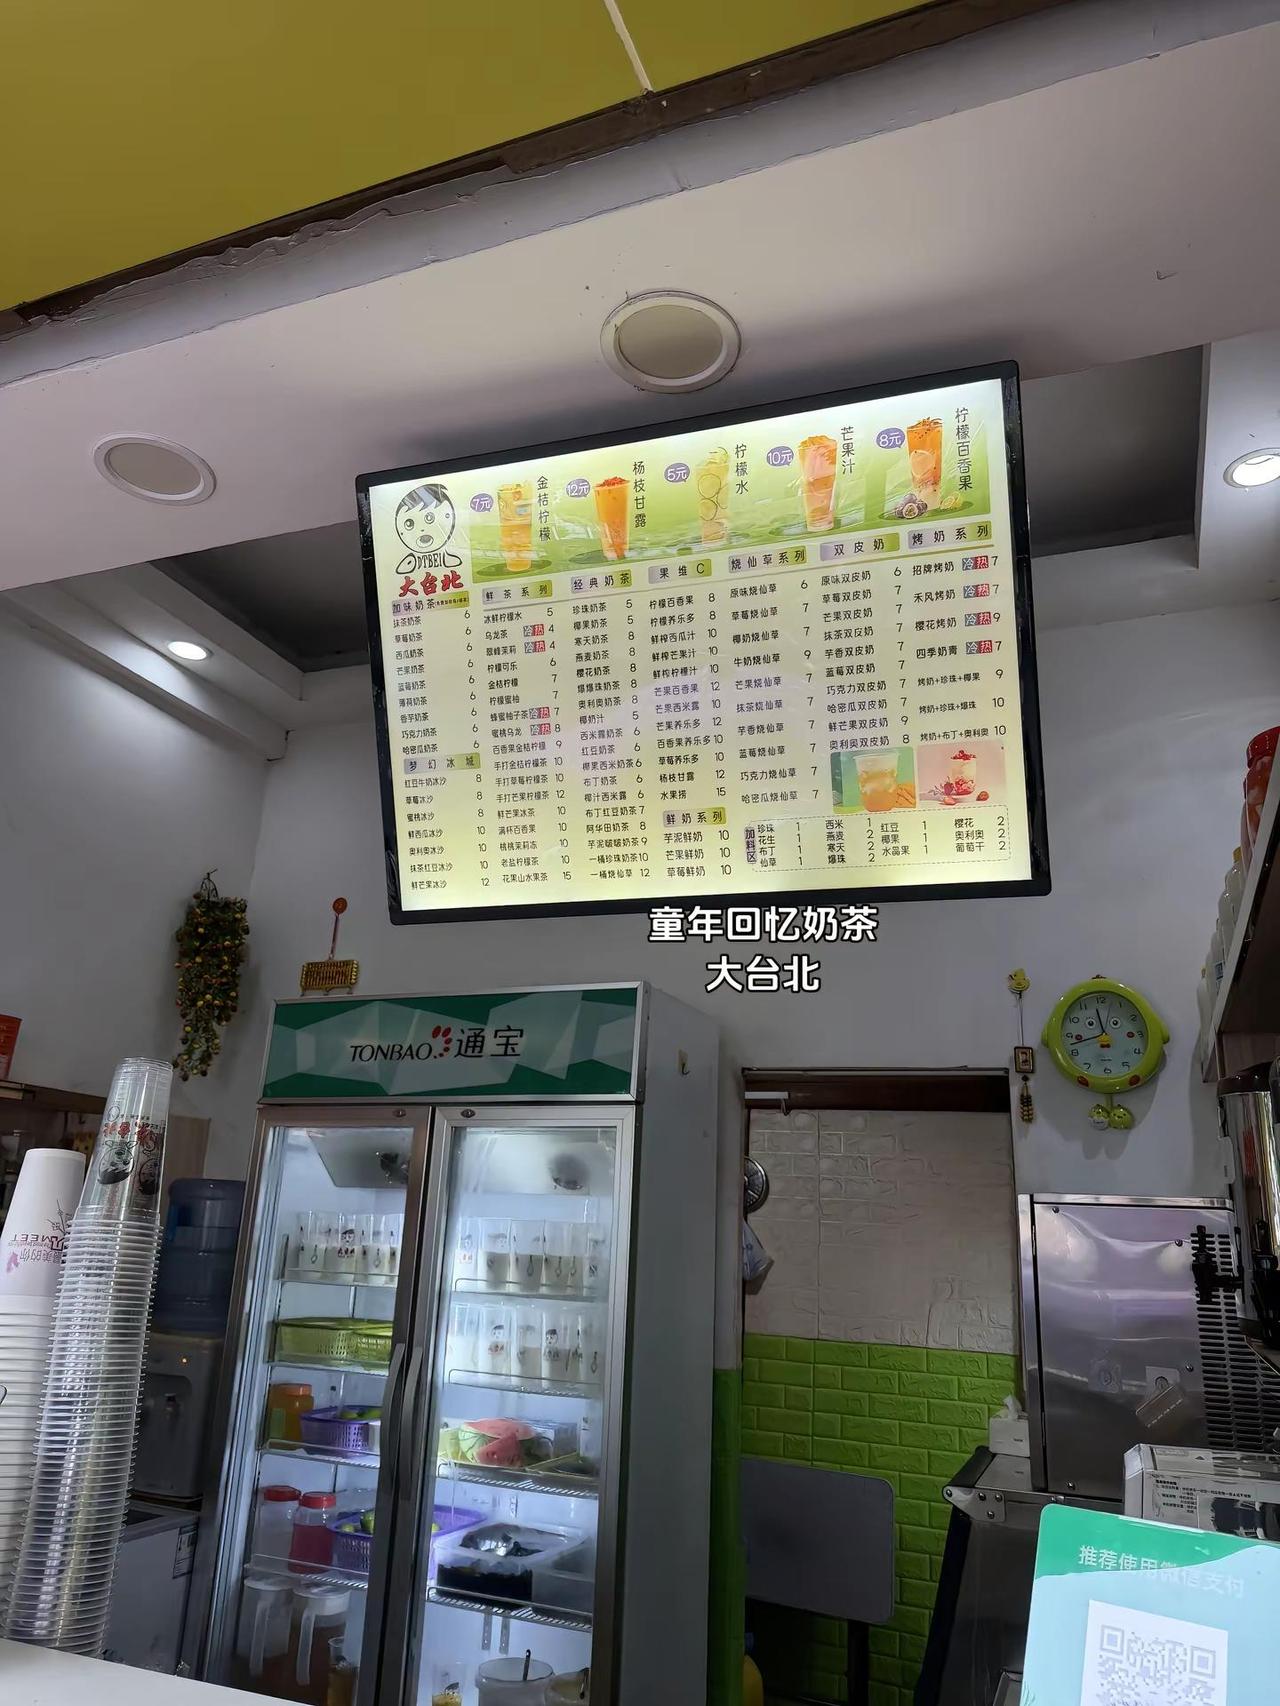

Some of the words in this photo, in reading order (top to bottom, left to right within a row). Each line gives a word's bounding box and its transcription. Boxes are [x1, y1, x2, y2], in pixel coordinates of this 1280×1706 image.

[880, 432, 902, 446] 8元
[841, 426, 855, 474] 芒果汁
[955, 408, 972, 491] 柠檬百香果
[768, 451, 792, 464] 10元
[668, 467, 688, 481] 5元
[735, 444, 748, 495] 柠檬水
[568, 482, 589, 495] 12元
[633, 461, 646, 528] 杨枝甘露
[473, 497, 491, 509] 7元
[537, 476, 550, 541] 金桔柠檬
[912, 525, 988, 545] 烤奶系列
[834, 538, 884, 556] 双皮奶
[731, 549, 805, 570] 烧仙草系列
[660, 563, 704, 579] 果维C
[913, 562, 954, 576] 招牌烤奶
[399, 570, 464, 597] 大台北
[574, 573, 630, 590] 经典奶茶
[821, 570, 871, 585] 原味双皮奶
[486, 585, 548, 600] 鲜茶系列
[730, 583, 777, 598] 原味烧仙草
[801, 580, 808, 589] 6
[650, 595, 693, 609] 柠檬百香果
[822, 589, 871, 604] 草莓双皮奶
[914, 589, 956, 603] 禾风烤奶
[392, 599, 435, 614] 加味奶茶
[573, 602, 606, 615] 珍珠奶茶
[626, 599, 632, 608] 5
[484, 611, 522, 624] 冰鲜柠檬水
[650, 613, 695, 627] 柠檬养乐多
[731, 607, 778, 620] 草莓烧仙草
[823, 608, 872, 622] 芒果双皮奶
[574, 619, 607, 630] 椰果奶茶
[915, 617, 957, 631] 樱花烤奶
[485, 630, 508, 640] 乌龙茶
[651, 631, 696, 644] 鲜榨西瓜汁
[733, 630, 779, 644] 椰奶烧仙草
[824, 626, 873, 641] 抹茶双皮奶
[574, 635, 608, 646] 寒天奶茶
[396, 649, 423, 660] 西瓜奶茶
[575, 650, 609, 662] 燕麦奶茶
[652, 649, 696, 662] 鲜榨芒果汁
[709, 646, 718, 655] 10
[825, 645, 874, 659] 芋香双皮奶
[917, 646, 957, 659] 四季奶青
[734, 653, 780, 667] 牛奶烧仙草
[488, 662, 518, 673] 柠檬可乐
[576, 666, 610, 678] 樱花奶茶
[653, 666, 697, 679] 鲜榨柠檬汁
[826, 663, 875, 677] 蓝莓双皮奶
[488, 678, 518, 690] 金桔柠檬
[735, 677, 782, 690] 芒果烧仙草
[918, 672, 980, 687] 烤奶+珍珠+椰果
[577, 681, 620, 694] 爆爆珠奶茶
[654, 683, 699, 696] 芒果百香果
[827, 681, 887, 695] 巧克力双皮奶
[579, 697, 621, 709] 奥利奥奶茶
[655, 701, 700, 714] 芒果西米露
[712, 699, 720, 708] 10
[736, 700, 783, 713] 抹茶烧仙草
[827, 699, 887, 713] 哈密瓜双皮奶
[992, 698, 1005, 707] 10
[579, 714, 604, 725] 椰奶汁
[656, 719, 701, 731] 芒果养乐多
[828, 718, 888, 732] 鲜芒果双皮奶
[901, 716, 908, 725] 9
[402, 728, 437, 739] 巧克力奶茶
[492, 728, 522, 738] 蜜桃乌龙
[580, 728, 623, 740] 西米露奶茶
[738, 723, 784, 736] 芋香烧仙草
[920, 728, 988, 742] 烤奶+布丁+奥利奥
[657, 735, 710, 749] 百香果养乐多
[830, 736, 889, 750] 奥利奥双皮奶
[403, 744, 438, 755] 哈密瓜奶茶
[581, 745, 615, 756] 红豆奶茶
[634, 743, 640, 751] 6
[739, 746, 785, 759] 蓝莓烧仙草
[494, 757, 547, 771] 手打金桔柠檬茶
[583, 759, 634, 771] 椰果西米奶茶
[658, 754, 699, 765] 草莓养乐多
[715, 752, 724, 761] 10
[496, 775, 548, 787] 手打草莓柠檬茶
[584, 776, 617, 786] 布丁奶茶
[660, 772, 694, 783] 杨枝甘露
[740, 768, 796, 781] 巧克力烧仙草
[405, 777, 446, 788] 红豆牛奶冰沙
[496, 791, 549, 803] 手打芒果柠檬茶
[557, 790, 565, 798] 12
[584, 791, 626, 802] 椰汁西米露
[661, 790, 687, 800] 水果捞
[742, 791, 798, 803] 哈密瓜烧仙草
[813, 790, 818, 798] 7
[498, 808, 535, 819] 鲜芒果冰茶
[585, 806, 637, 817] 布丁红豆奶茶
[667, 812, 723, 824] 鲜奶系列
[586, 822, 629, 833] 阿华田奶茶
[758, 824, 775, 833] 珍珠
[826, 820, 843, 830] 西米
[881, 823, 899, 832] 红豆
[955, 818, 974, 828] 樱花
[408, 829, 443, 839] 鲜西瓜冰沙
[478, 827, 485, 835] 10
[664, 832, 703, 844] 芋泥鲜奶
[719, 830, 729, 840] 10
[826, 832, 844, 842] 燕麦
[881, 835, 899, 844] 椰果
[955, 830, 984, 840] 奥利奥
[560, 839, 568, 847] 10
[758, 835, 775, 845] 花生
[760, 847, 775, 856] 布丁
[827, 843, 845, 852] 寒天
[956, 842, 984, 852] 葡萄干
[589, 853, 638, 864] 一桶珍珠奶茶
[639, 853, 648, 861] 10
[665, 849, 704, 860] 芒果鲜奶
[828, 854, 846, 864] 爆珠
[760, 859, 776, 868] 仙草
[502, 873, 548, 883] 花果山水果茶
[590, 869, 632, 879] 一桶烧仙草
[667, 867, 705, 877] 草莓鲜奶
[411, 880, 447, 890] 鲜芒果冰沙
[482, 878, 489, 886] 12
[351, 1044, 432, 1061] TONBAO
[454, 1026, 524, 1058] 通宝
[11, 1234, 51, 1242] MEET
